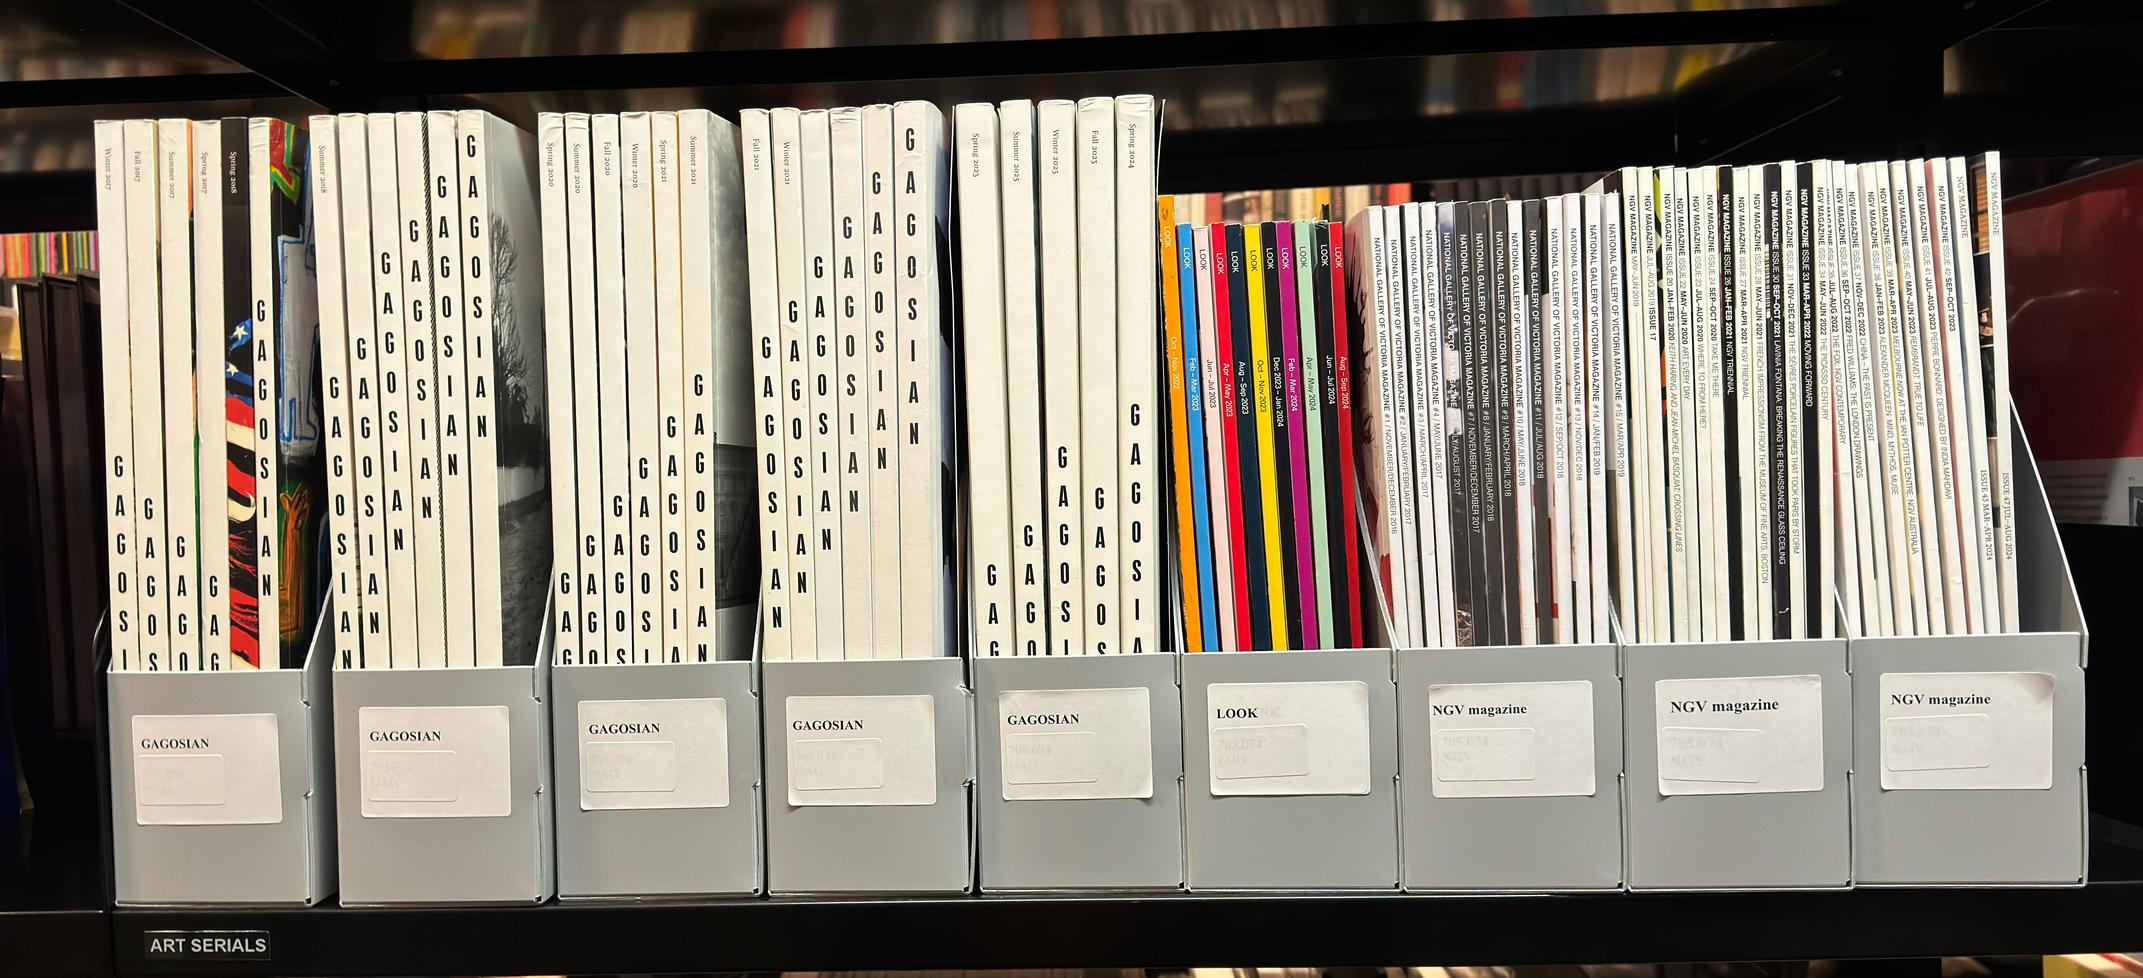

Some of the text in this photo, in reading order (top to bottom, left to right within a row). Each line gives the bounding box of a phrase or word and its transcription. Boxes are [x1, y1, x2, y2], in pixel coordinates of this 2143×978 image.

[1127, 123, 1137, 148] Spring
[545, 142, 555, 167] Spring
[603, 141, 612, 156] Fall
[659, 140, 668, 164] Spring
[689, 135, 697, 167] Summer
[971, 132, 980, 178] Spring 2023
[1051, 129, 1060, 175] Winter 2023
[104, 148, 112, 191] Winter 2017
[168, 151, 176, 181] Summer
[228, 151, 238, 194] Spring 2018
[318, 145, 328, 194] Summer 2018
[1644, 195, 1652, 212] NGV
[1722, 194, 1730, 211] NGV
[1800, 188, 1809, 206] NGV
[1938, 185, 1946, 202] NGV
[1645, 213, 1654, 254] MAGAZINE
[1722, 212, 1731, 253] MAGAZINE
[1801, 207, 1810, 248] MAGAZINE
[1939, 203, 1949, 244] MAGAZINE
[1163, 225, 1172, 248] LOOK
[1608, 223, 1617, 265] NATIONAL
[1183, 247, 1192, 270] LOOK
[1199, 248, 1208, 271] LOOK
[1230, 251, 1240, 273] LOOK
[1249, 249, 1258, 272] LOOK
[1266, 247, 1274, 270] LOOK
[1281, 247, 1290, 270] LOOK
[1299, 246, 1308, 269] LOOK
[1320, 244, 1329, 267] LOOK
[1334, 246, 1343, 269] LOOK
[1374, 237, 1383, 278] NATIONAL
[1495, 231, 1504, 272] NATIONAL
[1801, 249, 1810, 271] ISSUE
[1216, 252, 1225, 275] LOOK
[1723, 254, 1732, 276] ISSUE
[466, 134, 487, 438] GAGOSIAN
[905, 127, 919, 445] GAGOSIAN
[1609, 265, 1619, 303] GALLERY
[1724, 276, 1732, 286] 26
[1802, 272, 1810, 281] 33
[1376, 279, 1385, 316] GALLERY
[1496, 273, 1506, 311] GALLERY
[872, 171, 887, 470] GAGOSIAN
[1498, 312, 1506, 324] OF
[1611, 304, 1619, 316] OF
[1648, 307, 1657, 330] ISSUE
[437, 175, 458, 476] GAGOSIAN
[1378, 317, 1386, 328] OF
[1725, 321, 1733, 339] 2021
[1803, 320, 1811, 339] 2022
[1948, 314, 1956, 332] 2023
[1498, 324, 1507, 364] VICTORIA
[1612, 317, 1621, 357] VICTORIA
[1650, 332, 1657, 341] 17
[1379, 330, 1388, 368] VICTORIA
[1725, 341, 1734, 357] NGV
[1804, 339, 1813, 370] MOVING
[409, 219, 432, 519] GAGOSIAN
[842, 216, 859, 513] GAGOSIAN
[1189, 357, 1197, 372] Feb
[1238, 361, 1246, 376] Aug
[1273, 356, 1281, 372] Dec
[1305, 356, 1314, 370] Apr
[1190, 378, 1198, 394] Mar
[1274, 372, 1282, 390] 2023
[1307, 377, 1315, 394] May
[1500, 364, 1509, 408] MAGAZINE
[1613, 358, 1623, 401] MAGAZINE
[1726, 358, 1734, 395] TRIENNIAL
[1239, 382, 1248, 397] Sep
[1382, 369, 1391, 411] MAGAZINE
[1804, 370, 1813, 407] FORWARD
[381, 252, 404, 551] GAGOSIAN
[813, 255, 832, 551] GAGOSIAN
[1191, 394, 1200, 412] 2023
[1241, 397, 1250, 415] 2023
[1275, 396, 1283, 410] Jan
[1308, 394, 1316, 411] 2024
[1276, 410, 1284, 427] 2024
[256, 299, 271, 596] GAGOSIAN
[788, 300, 807, 594] GAGOSIAN
[1616, 459, 1625, 478] 2019
[356, 337, 380, 634] GAGOSIAN
[761, 336, 782, 629] GAGOSIAN
[1504, 479, 1512, 497] 2018
[329, 376, 352, 670] GAGOSIAN
[694, 373, 708, 663] GAGOSIAN
[1390, 517, 1398, 535] 2016
[1433, 703, 1527, 718] NGV magazine
[1670, 698, 1779, 715] NGV magazine
[1891, 693, 1991, 707] NGV magazine
[792, 719, 863, 731] GAGOSIAN
[1007, 713, 1079, 726] GAGOSIAN
[1216, 708, 1258, 719] LOOK
[369, 731, 441, 742] GAGOSIAN
[588, 723, 660, 735] GAGOSIAN
[141, 738, 209, 749] GAGOSIAN
[150, 938, 267, 953] ART SERIALS
